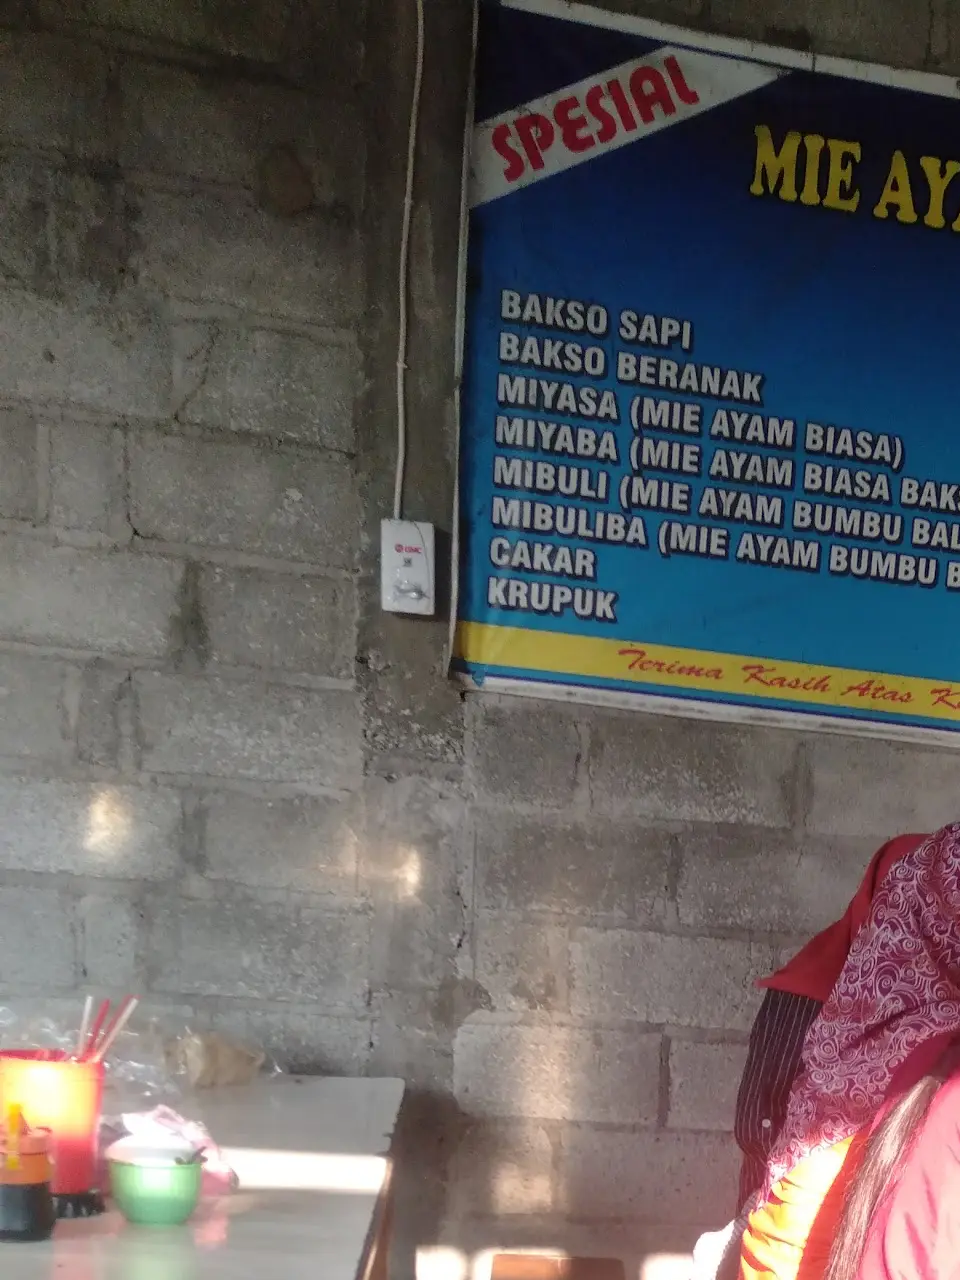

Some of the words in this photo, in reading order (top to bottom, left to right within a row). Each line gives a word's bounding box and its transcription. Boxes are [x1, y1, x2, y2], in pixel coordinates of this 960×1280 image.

[491, 54, 700, 184] SPESIAL
[750, 124, 862, 213] MIE
[501, 290, 608, 335] BAKSO
[619, 310, 692, 350] SAPI
[499, 333, 605, 377] BAKSO
[617, 352, 763, 401] BERANAK
[494, 416, 618, 461] MIYABA
[629, 436, 700, 473] (MIE
[709, 449, 794, 486] AYAM
[803, 462, 890, 501] BIASA
[497, 374, 619, 420] MIYASA
[630, 396, 700, 432] (MIE
[710, 409, 794, 446] AYAM
[805, 422, 902, 469] BIASA)
[491, 497, 647, 546] MIBULIBA
[658, 521, 729, 557] (MIE
[736, 533, 819, 570] AYAM
[829, 544, 937, 586] BUMBU
[493, 456, 607, 500] MIBULI
[619, 475, 691, 511] (MIE
[699, 487, 782, 525] AYAM
[792, 500, 902, 542] BUMBU
[487, 577, 616, 621] KRUPUK
[489, 536, 596, 578] CAKAR
[618, 648, 724, 681] Terima
[742, 664, 831, 693] Kasih
[841, 678, 913, 703] Atas
